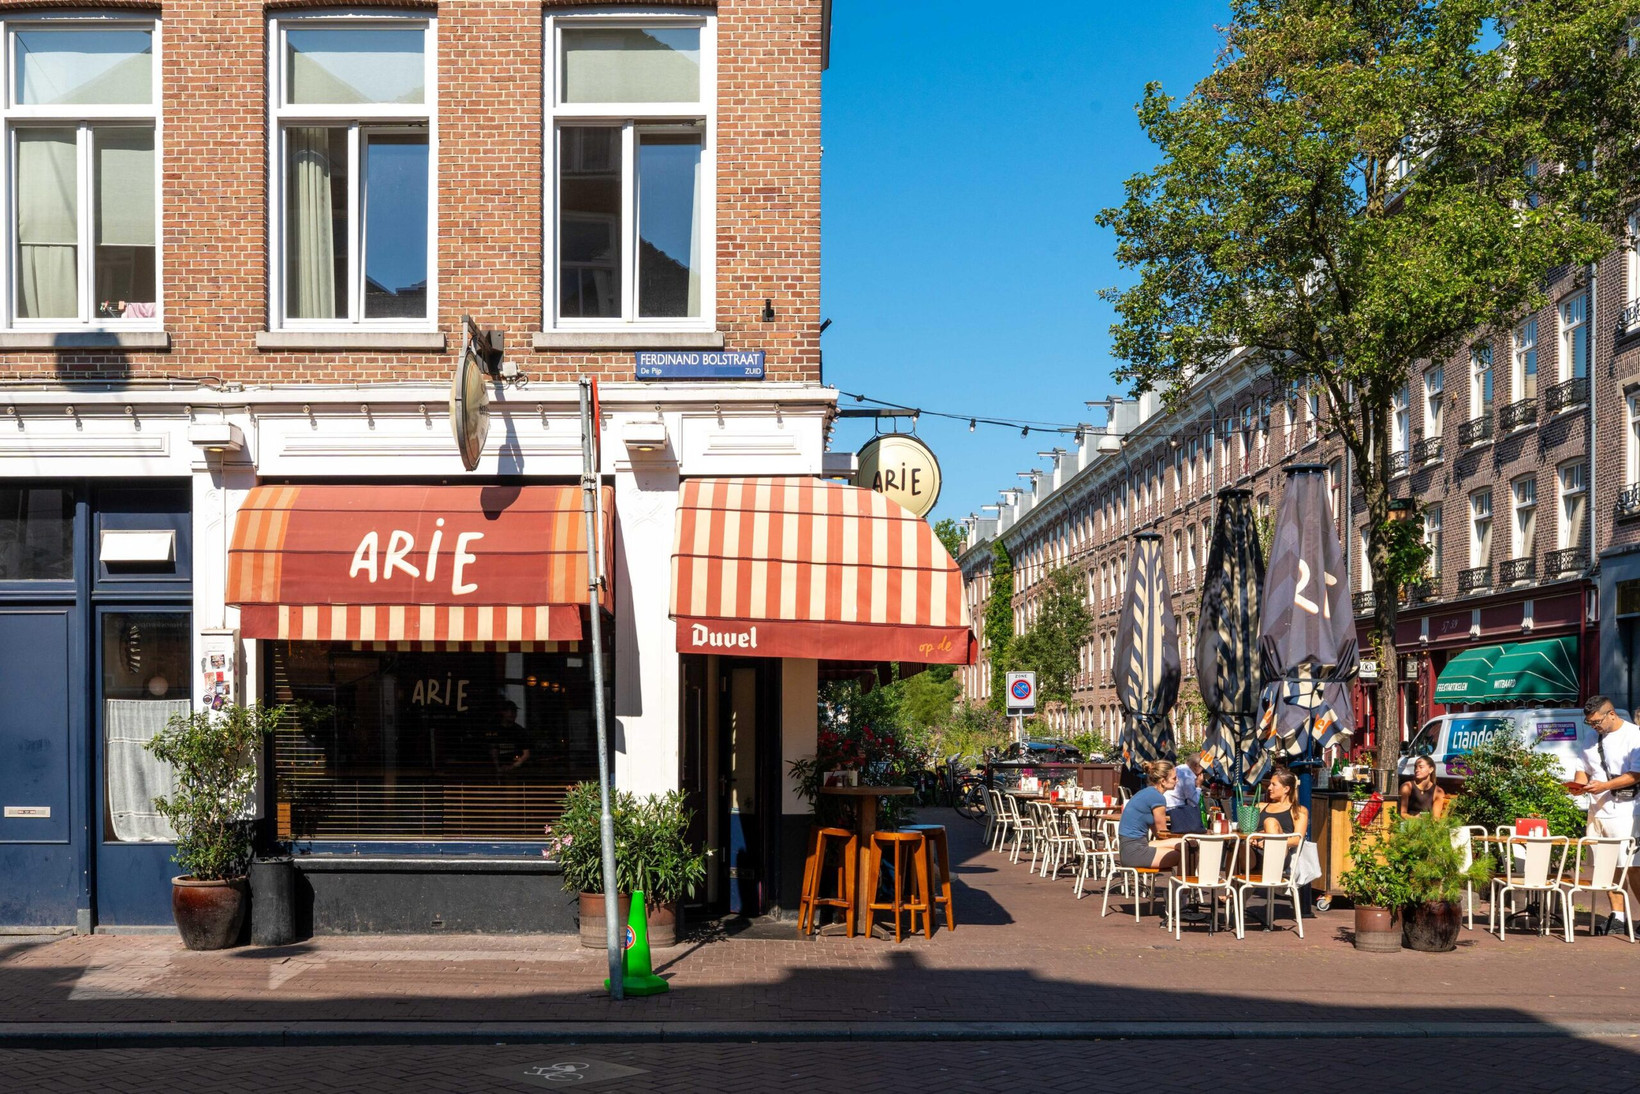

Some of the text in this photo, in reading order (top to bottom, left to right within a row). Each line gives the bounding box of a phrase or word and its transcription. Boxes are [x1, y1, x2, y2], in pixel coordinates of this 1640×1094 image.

[640, 354, 760, 365] FERDINAND BOLSTRAAT
[691, 623, 757, 649] Duvel
[919, 635, 952, 657] op de
